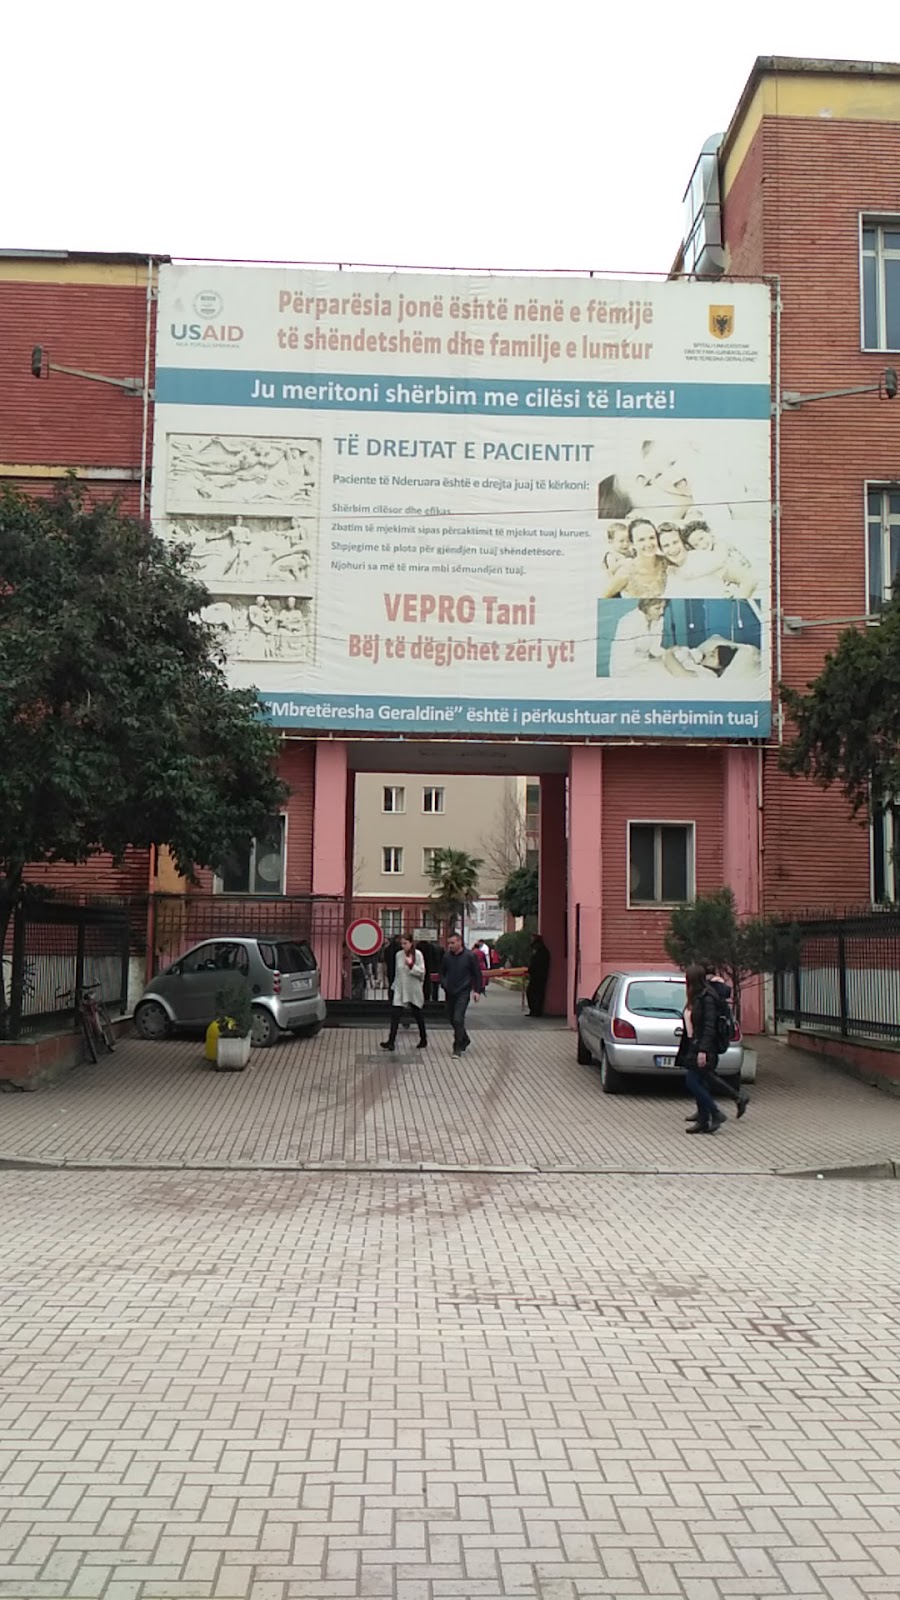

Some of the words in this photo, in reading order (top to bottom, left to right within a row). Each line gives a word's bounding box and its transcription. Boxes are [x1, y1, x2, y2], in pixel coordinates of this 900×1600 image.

[279, 290, 392, 321] Përparësia
[397, 293, 444, 323] jonë
[449, 296, 508, 321] është
[514, 299, 564, 322] nënë
[569, 306, 581, 322] e
[587, 300, 653, 330] fëmijë
[170, 323, 244, 342] USAID
[277, 326, 299, 349] të
[303, 326, 442, 354] shëndetshëm
[447, 331, 485, 356] dhe
[490, 332, 561, 364] familje
[566, 340, 577, 357] e
[582, 335, 653, 360] lumtur
[250, 379, 276, 399] Ju
[282, 382, 379, 402] meritoni
[385, 384, 477, 406] shërbim
[483, 390, 519, 407] me
[525, 387, 580, 410] cilësi
[587, 390, 609, 409] të
[616, 390, 676, 410] lartë!
[333, 433, 360, 456] TË
[366, 438, 457, 459] DREJTAT
[464, 441, 476, 460] E
[483, 443, 594, 461] PACIENTIT
[333, 474, 377, 485] Paciente
[379, 475, 390, 486] të
[392, 476, 440, 488] Nderuara
[442, 478, 471, 489] është
[482, 479, 512, 491] drejta
[514, 480, 533, 491] juaj
[536, 481, 547, 490] të
[548, 480, 590, 491] kërkoni:
[332, 503, 371, 514] Shërbim
[372, 505, 402, 515] cilësor
[404, 506, 422, 516] dhe
[331, 523, 363, 533] Zbatim
[365, 524, 375, 533] të
[376, 525, 416, 535] mjekimit
[418, 526, 441, 536] sipas
[442, 527, 493, 537] përcaktimit
[495, 528, 505, 537] të
[506, 528, 538, 539] mjekut
[540, 529, 558, 539] tuaj
[559, 529, 592, 538] kurues.
[331, 542, 380, 553] Shpjegime
[381, 543, 392, 552] të
[393, 544, 417, 554] plota
[419, 545, 435, 555] për
[480, 546, 498, 557] tuaj
[500, 547, 565, 557] shëndetësore.
[331, 561, 366, 571] Njohuri
[380, 562, 395, 571] më
[397, 563, 407, 571] të
[409, 563, 430, 572] mira
[431, 564, 450, 573] mbi
[452, 564, 503, 576] sëmundjen
[505, 565, 527, 576] tuaj.
[384, 593, 476, 624] VEPRO
[482, 596, 537, 626] Tani
[349, 634, 380, 664] Bëj
[385, 635, 406, 659] të
[411, 635, 500, 667] dëgjohet
[505, 638, 542, 663] zëri
[547, 640, 576, 669] yt!
[467, 707, 509, 723] është
[513, 708, 519, 723] i
[521, 708, 617, 726] përkushtuar
[620, 709, 641, 724] në
[644, 708, 724, 725] shërbimin
[727, 711, 759, 729] tuaj
